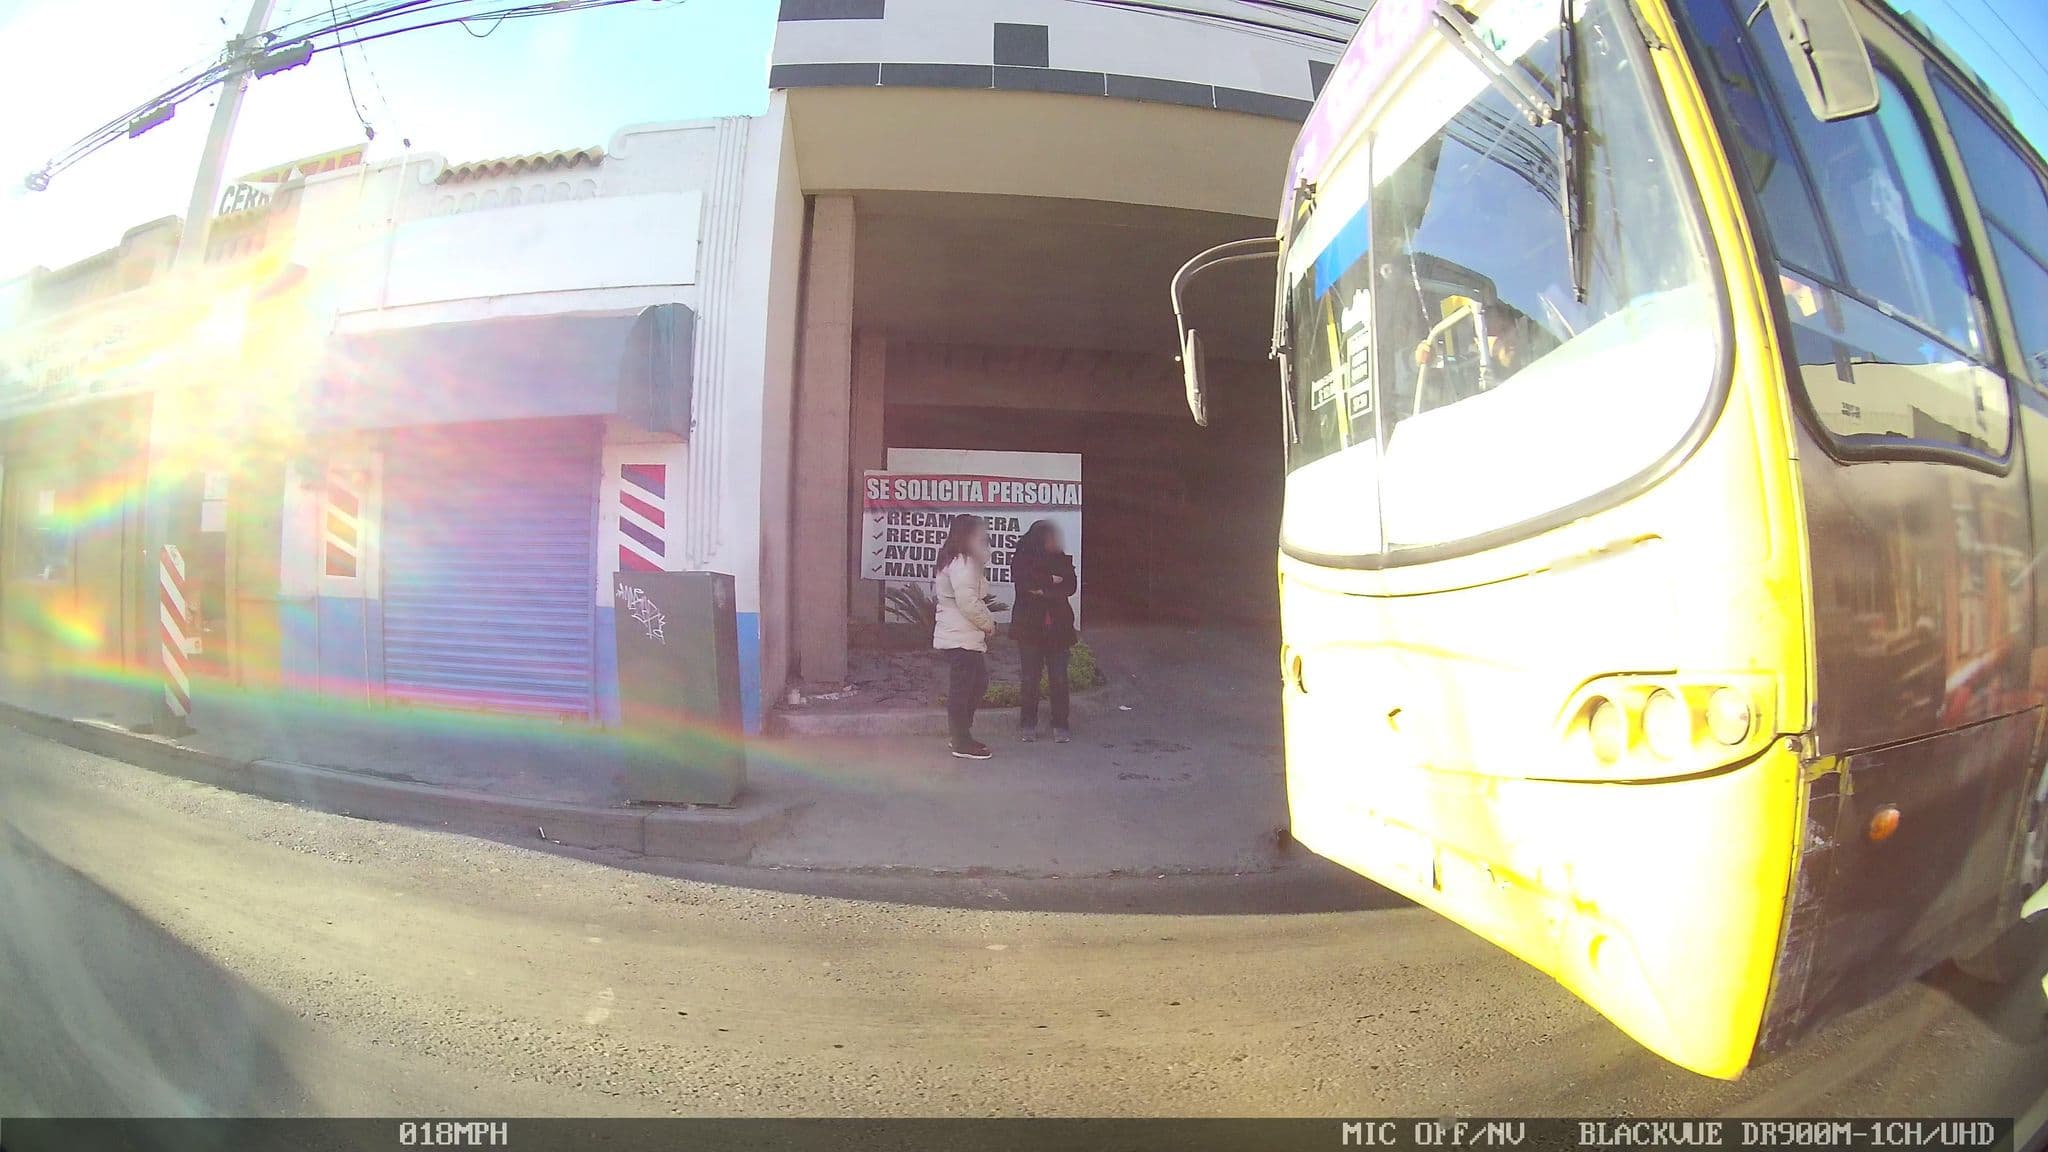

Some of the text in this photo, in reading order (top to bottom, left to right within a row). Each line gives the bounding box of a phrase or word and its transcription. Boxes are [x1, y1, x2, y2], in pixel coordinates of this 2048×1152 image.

[867, 478, 889, 500] SE
[894, 479, 984, 503] SOLICITA
[887, 511, 1020, 532] RECAMERA
